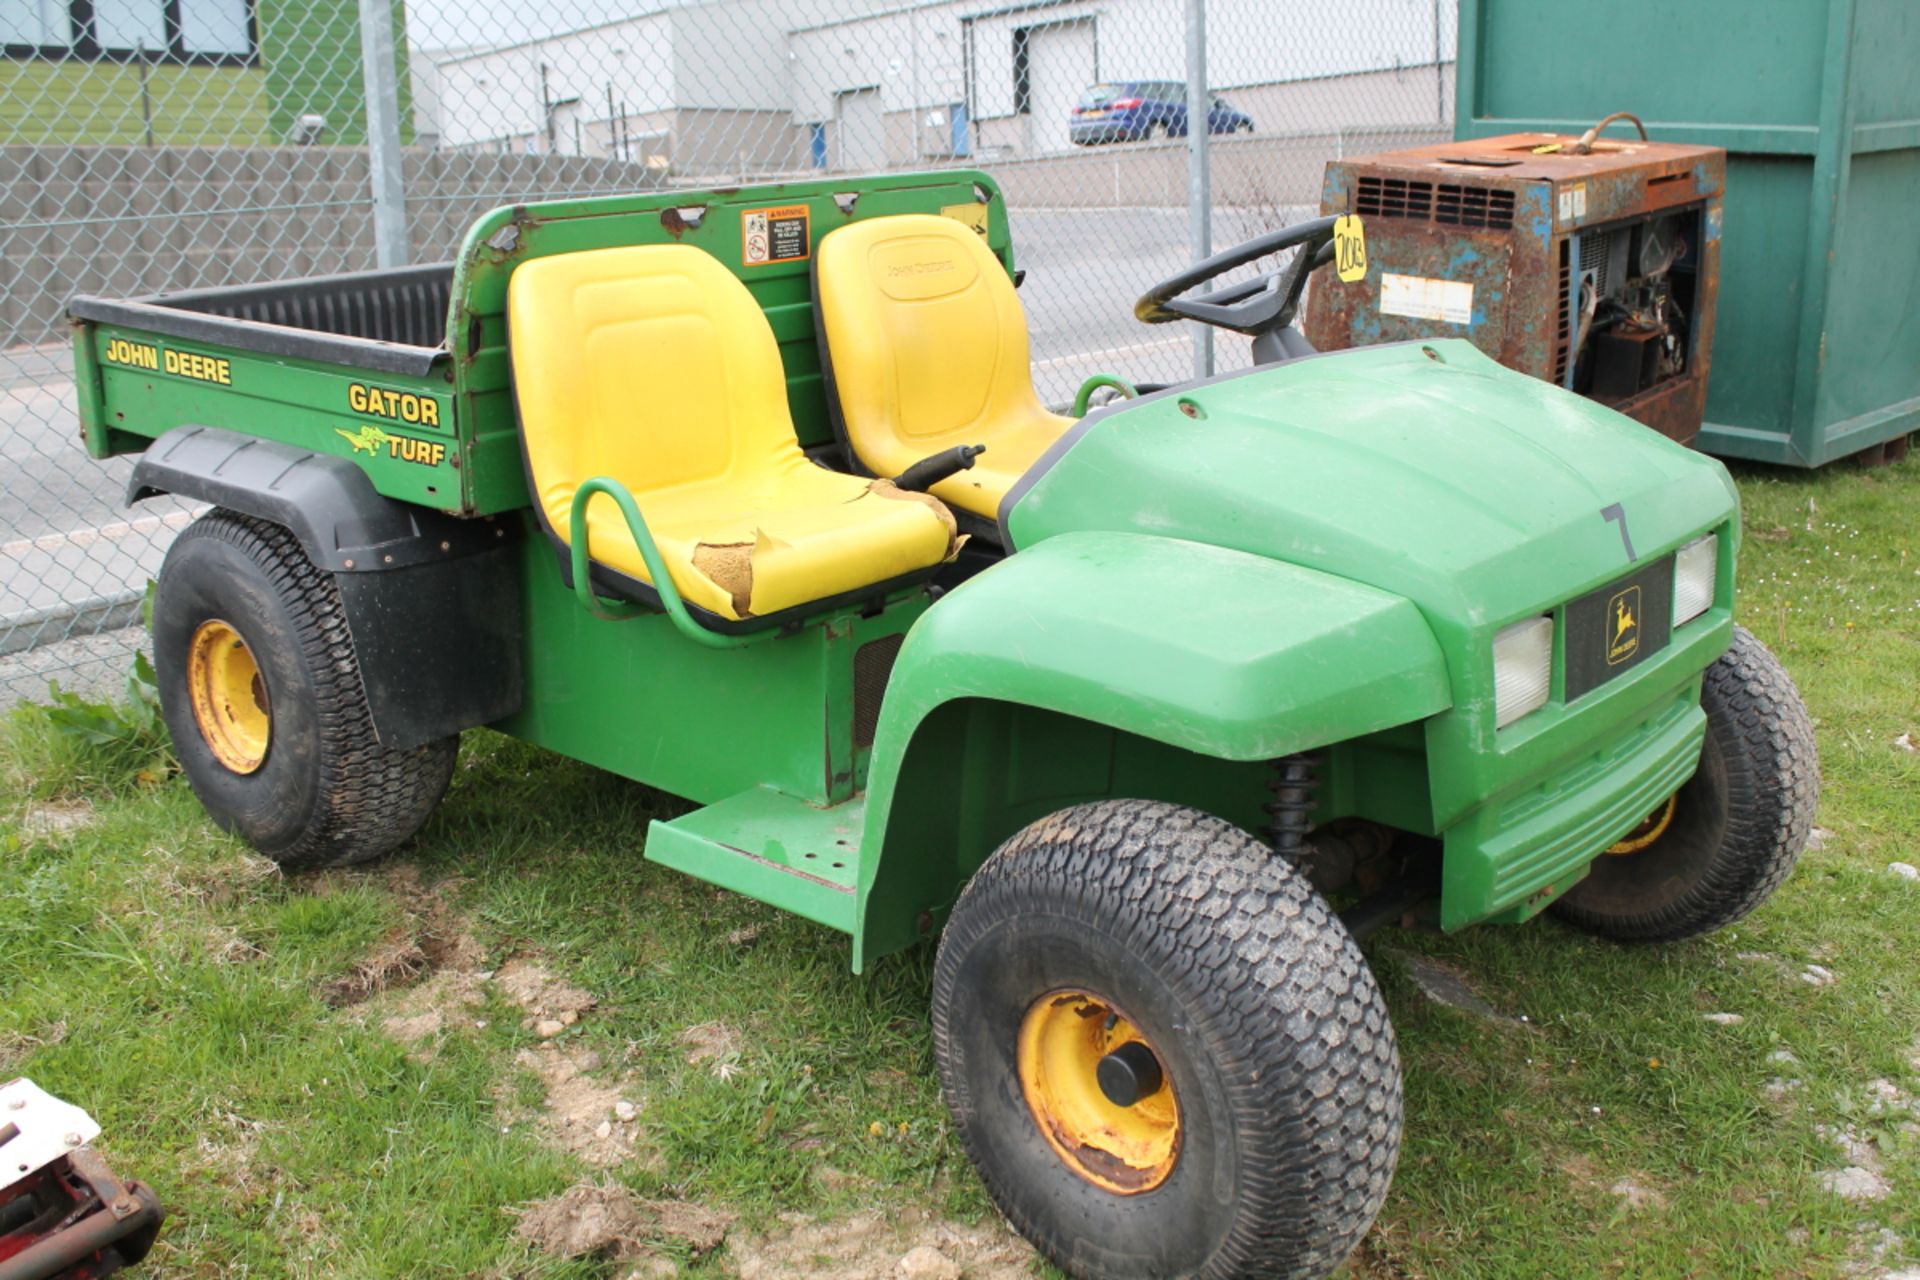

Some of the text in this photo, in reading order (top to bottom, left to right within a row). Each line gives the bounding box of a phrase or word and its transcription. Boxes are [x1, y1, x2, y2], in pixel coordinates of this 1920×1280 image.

[775, 208, 805, 217] WARNING
[887, 259, 955, 277] JOHN DEERE
[107, 338, 232, 386] JOHN DEERE
[349, 383, 439, 427] GATOR
[386, 434, 446, 467] TURF
[1600, 502, 1637, 563] 7
